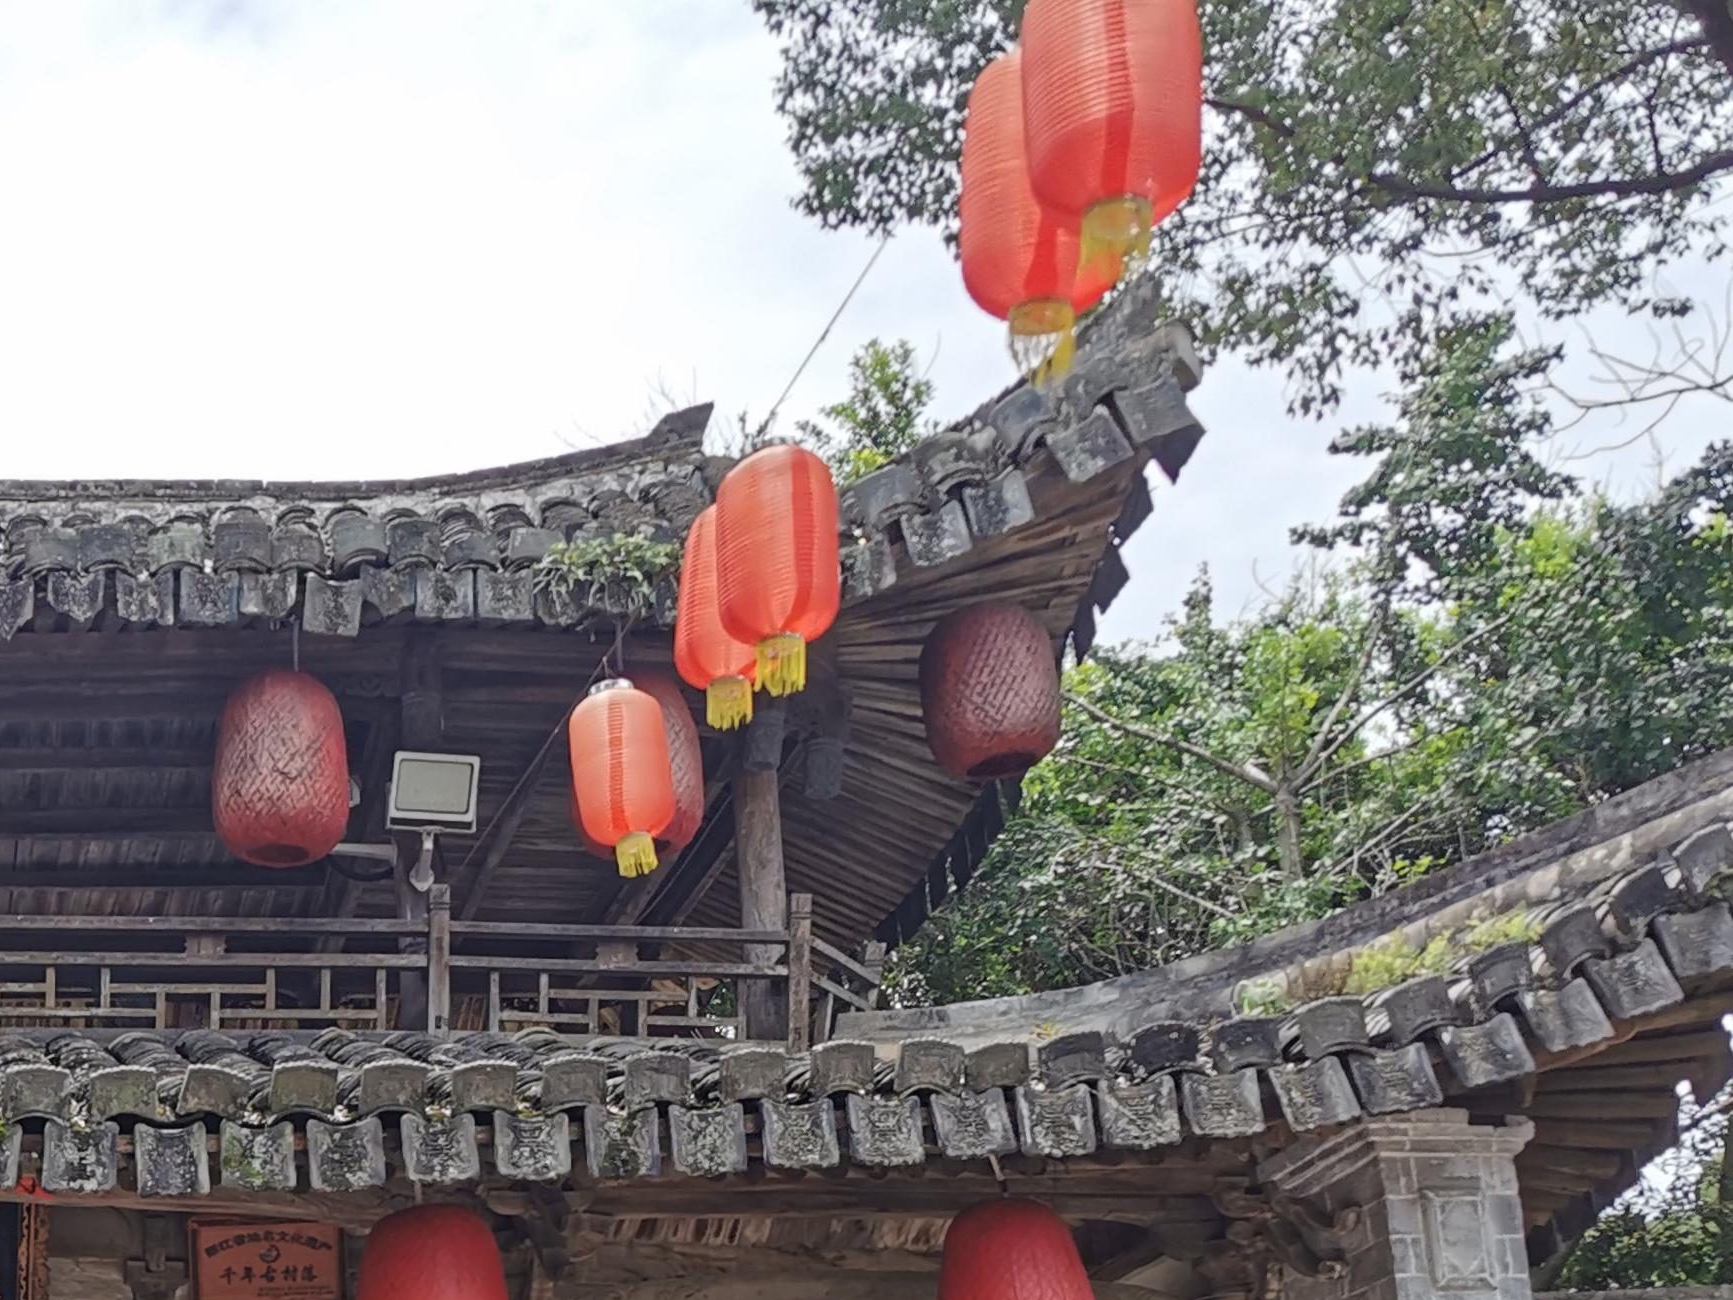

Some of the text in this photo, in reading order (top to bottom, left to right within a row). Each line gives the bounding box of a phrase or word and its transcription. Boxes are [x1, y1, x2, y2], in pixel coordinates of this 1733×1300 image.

[220, 1264, 317, 1285] 千年古村落
